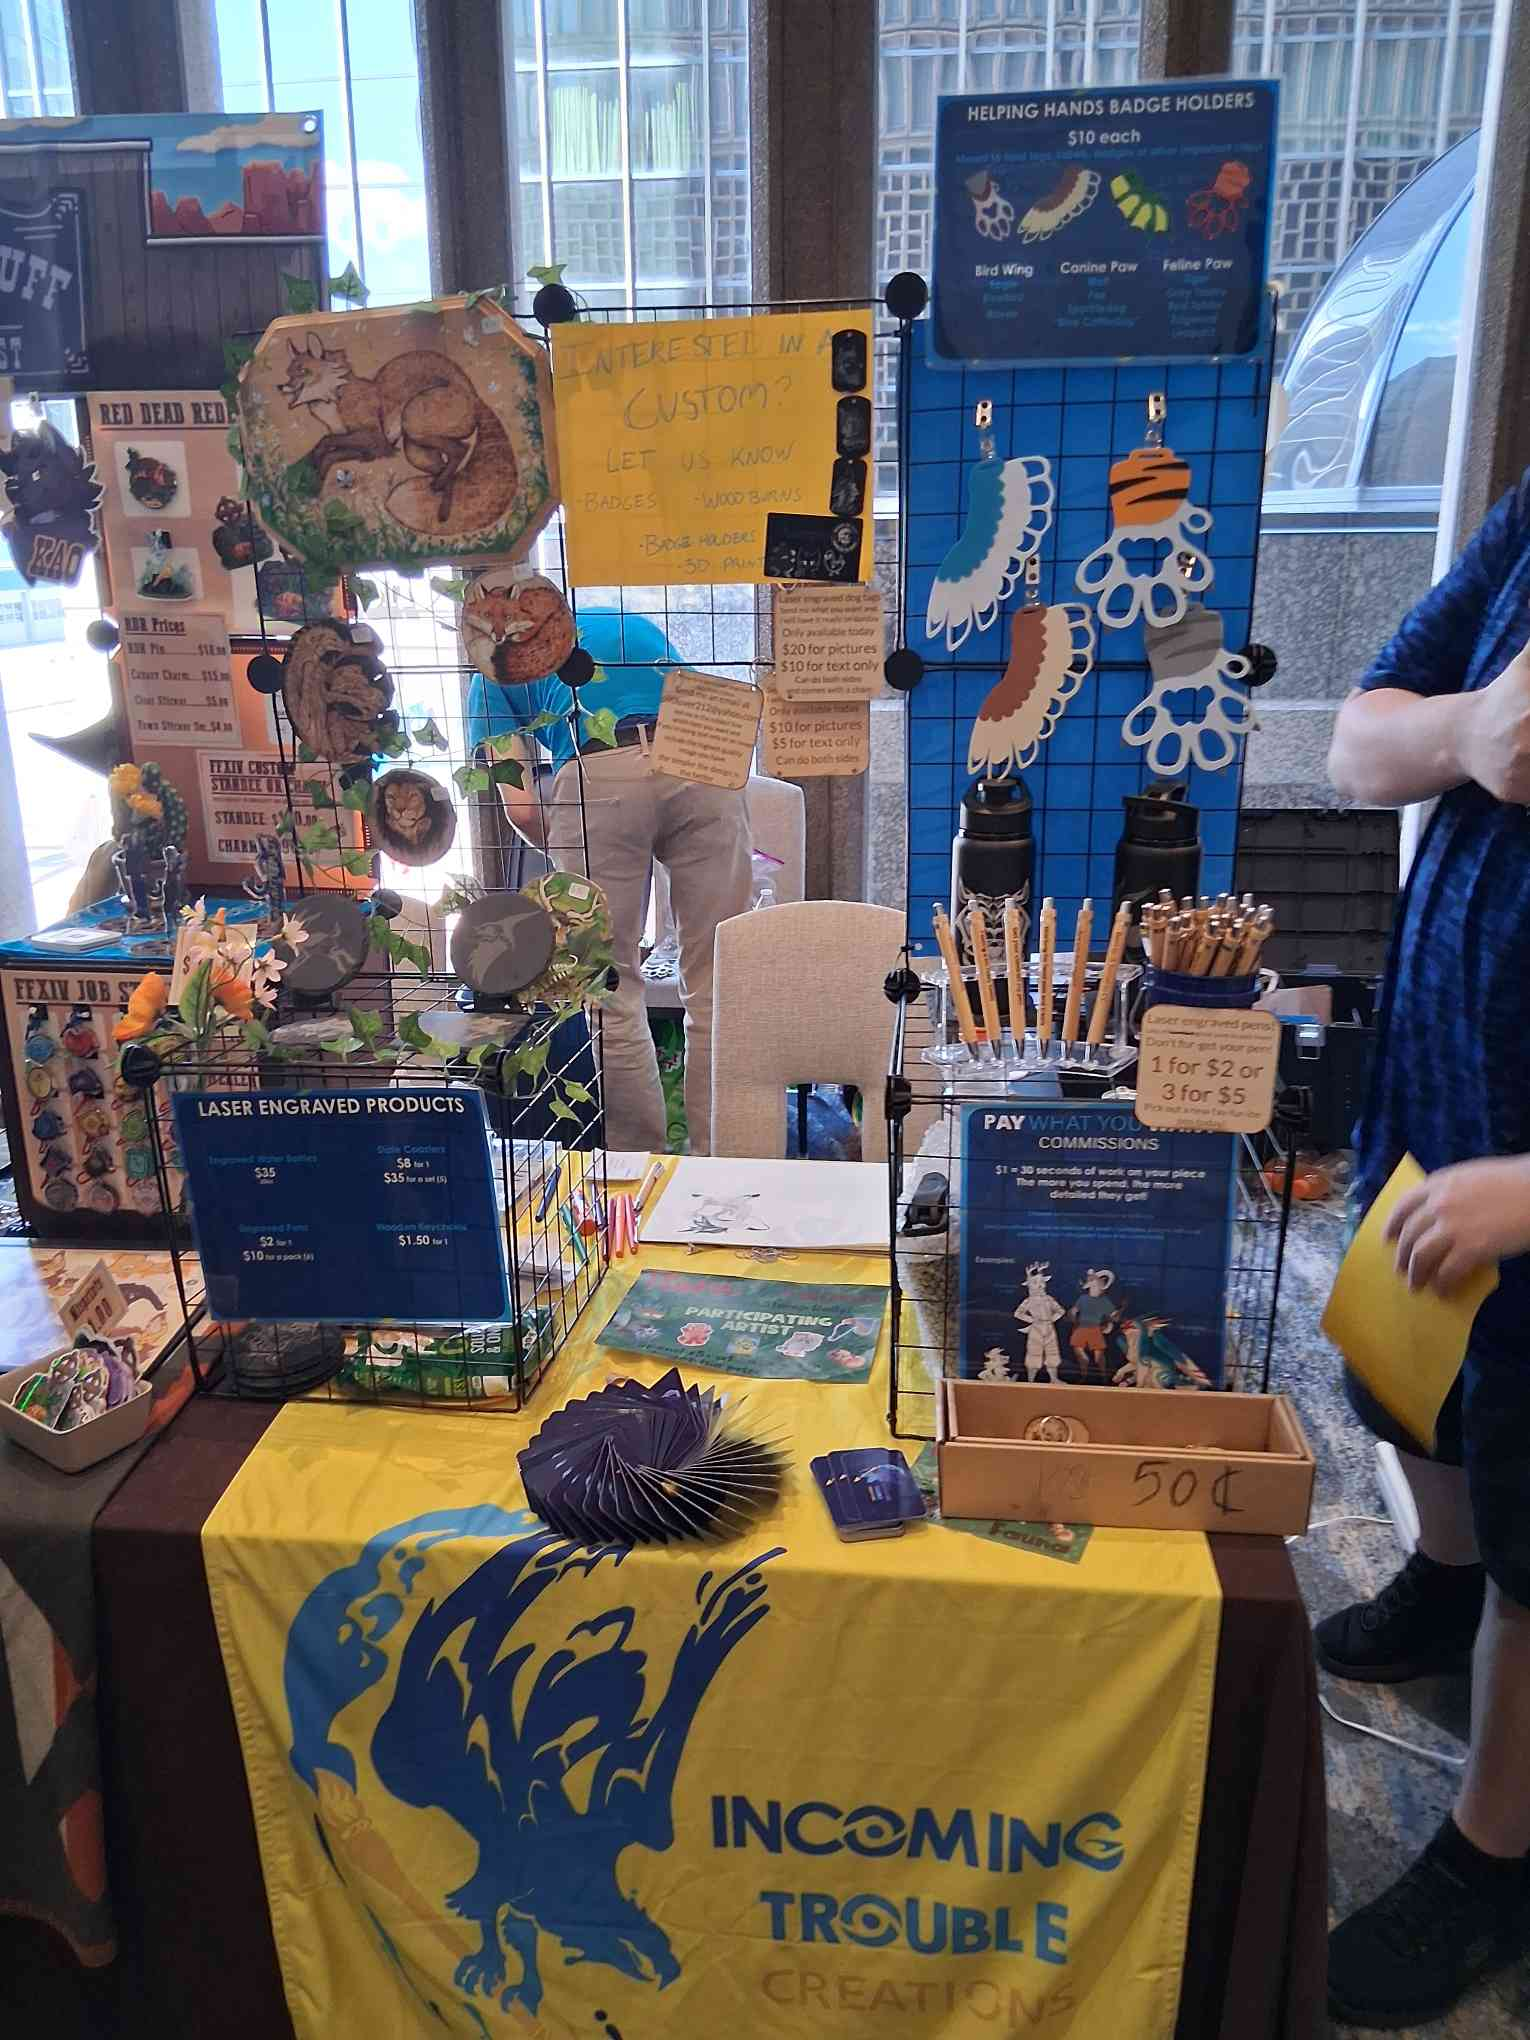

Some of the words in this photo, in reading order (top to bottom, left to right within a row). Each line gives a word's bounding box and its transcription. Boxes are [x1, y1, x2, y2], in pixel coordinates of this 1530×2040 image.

[968, 103, 1039, 122] HELPING
[1043, 99, 1104, 118] HANDS
[1109, 96, 1172, 115] BADGE
[1175, 92, 1256, 111] HOLDERS
[1067, 130, 1096, 147] $10
[1099, 129, 1141, 144] each
[975, 264, 999, 277] Bird
[1000, 263, 1035, 279] Wing
[1060, 261, 1108, 274] Canine
[1110, 260, 1138, 273] Paw
[1162, 259, 1201, 272] Feline
[1204, 257, 1233, 271] Paw
[558, 331, 757, 380] INTERESTED
[779, 334, 804, 354] IN
[99, 402, 134, 425] RED
[140, 401, 185, 425] DEAD
[191, 401, 228, 425] RED
[607, 448, 657, 474] LET
[681, 450, 712, 473] US
[730, 439, 795, 467] KNOW
[151, 617, 185, 634] Prices
[783, 643, 806, 656] $20
[808, 643, 825, 655] for
[828, 642, 878, 657] pictures
[782, 660, 805, 673] $10
[806, 660, 823, 672] for
[826, 661, 851, 672] text
[852, 659, 880, 673] only
[769, 721, 793, 735] $10
[795, 720, 812, 733] for
[814, 719, 864, 734] pictures
[772, 737, 787, 750] $5
[789, 737, 806, 749] for
[809, 738, 834, 748] text
[834, 735, 861, 748] only
[775, 755, 796, 766] Can
[810, 754, 834, 765] both
[211, 777, 263, 793] STANDEE
[14, 978, 69, 1001] FFXIV
[77, 979, 111, 1002] JOB
[1146, 1013, 1180, 1025] Laser
[1183, 1016, 1239, 1030] engraved
[1151, 1055, 1163, 1073] 1
[1168, 1056, 1201, 1075] for
[1207, 1058, 1234, 1079] $2
[1239, 1064, 1264, 1079] or
[1161, 1082, 1176, 1101] 3
[1180, 1083, 1213, 1102] for
[1218, 1085, 1246, 1105] $5
[199, 1099, 253, 1118] LASER
[258, 1096, 361, 1116] ENGRAVED
[366, 1095, 465, 1114] PRODUCTS
[984, 1114, 1026, 1131] PAY
[1029, 1115, 1092, 1132] WHAT
[1096, 1115, 1143, 1132] YOU
[1038, 1136, 1160, 1151] COMMISSIONS
[396, 1157, 412, 1169] $8
[254, 1167, 276, 1179] $35
[383, 1172, 405, 1185] $35
[1020, 1165, 1034, 1176] 30
[1036, 1165, 1083, 1177] seconds
[1084, 1166, 1096, 1177] of
[1098, 1167, 1124, 1178] work
[1127, 1169, 1143, 1177] on
[1144, 1169, 1171, 1180] your
[1172, 1168, 1206, 1180] piece
[1016, 1178, 1035, 1188] The
[1037, 1179, 1067, 1188] more
[1068, 1180, 1090, 1190] you
[1132, 1179, 1151, 1189] the
[1153, 1181, 1184, 1191] more
[1049, 1190, 1096, 1201] detailed
[1098, 1191, 1122, 1202] they
[259, 1236, 275, 1248] $2
[398, 1234, 430, 1247] $1.50
[242, 1250, 264, 1262] $10
[684, 1305, 834, 1328] PARTICIPATING
[719, 1318, 795, 1337] ARTIST
[710, 1795, 1126, 1873] INCOMING
[759, 1890, 1069, 1966] TROUBLE
[760, 1968, 1078, 2029] CREATIONS
